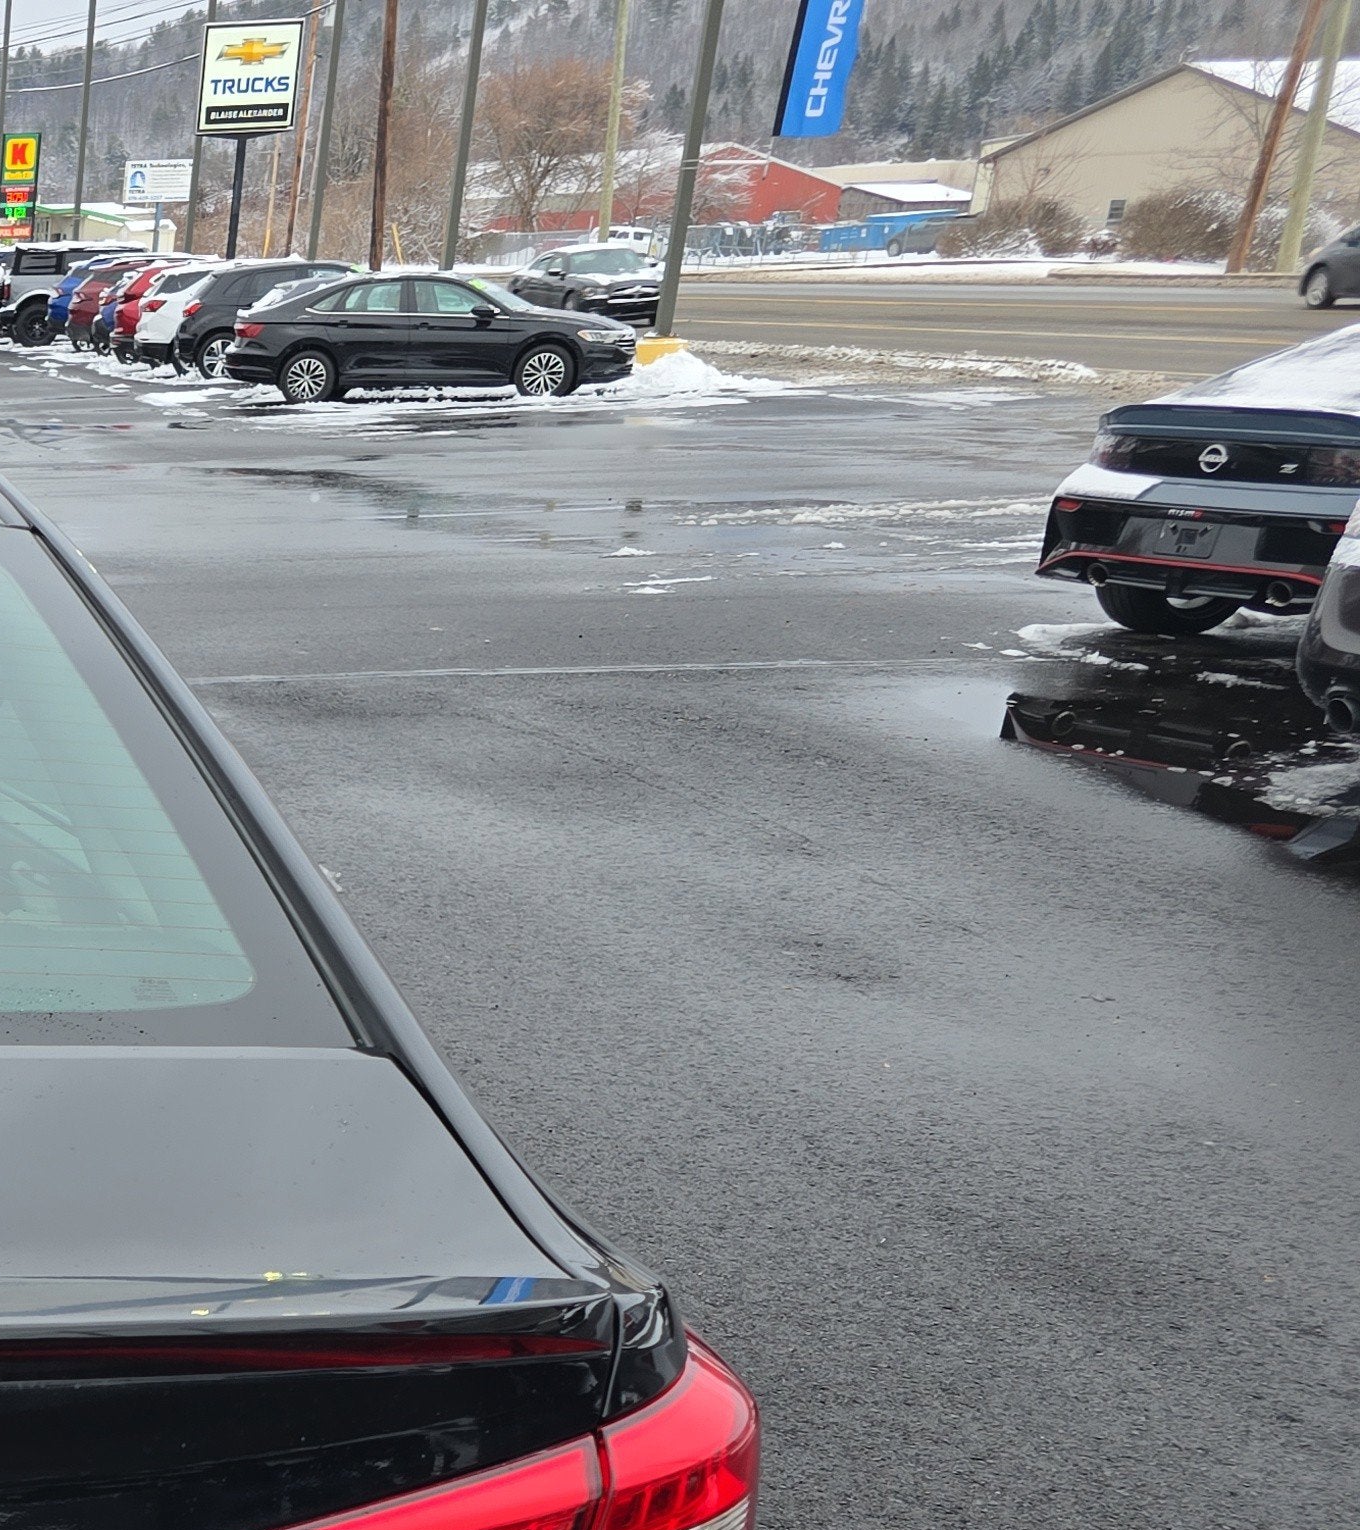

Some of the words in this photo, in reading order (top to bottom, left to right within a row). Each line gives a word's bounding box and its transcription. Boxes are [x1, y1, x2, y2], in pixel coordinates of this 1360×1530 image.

[210, 76, 290, 95] TRUCKS
[238, 108, 284, 118] ALEXANDER
[11, 143, 28, 165] K
